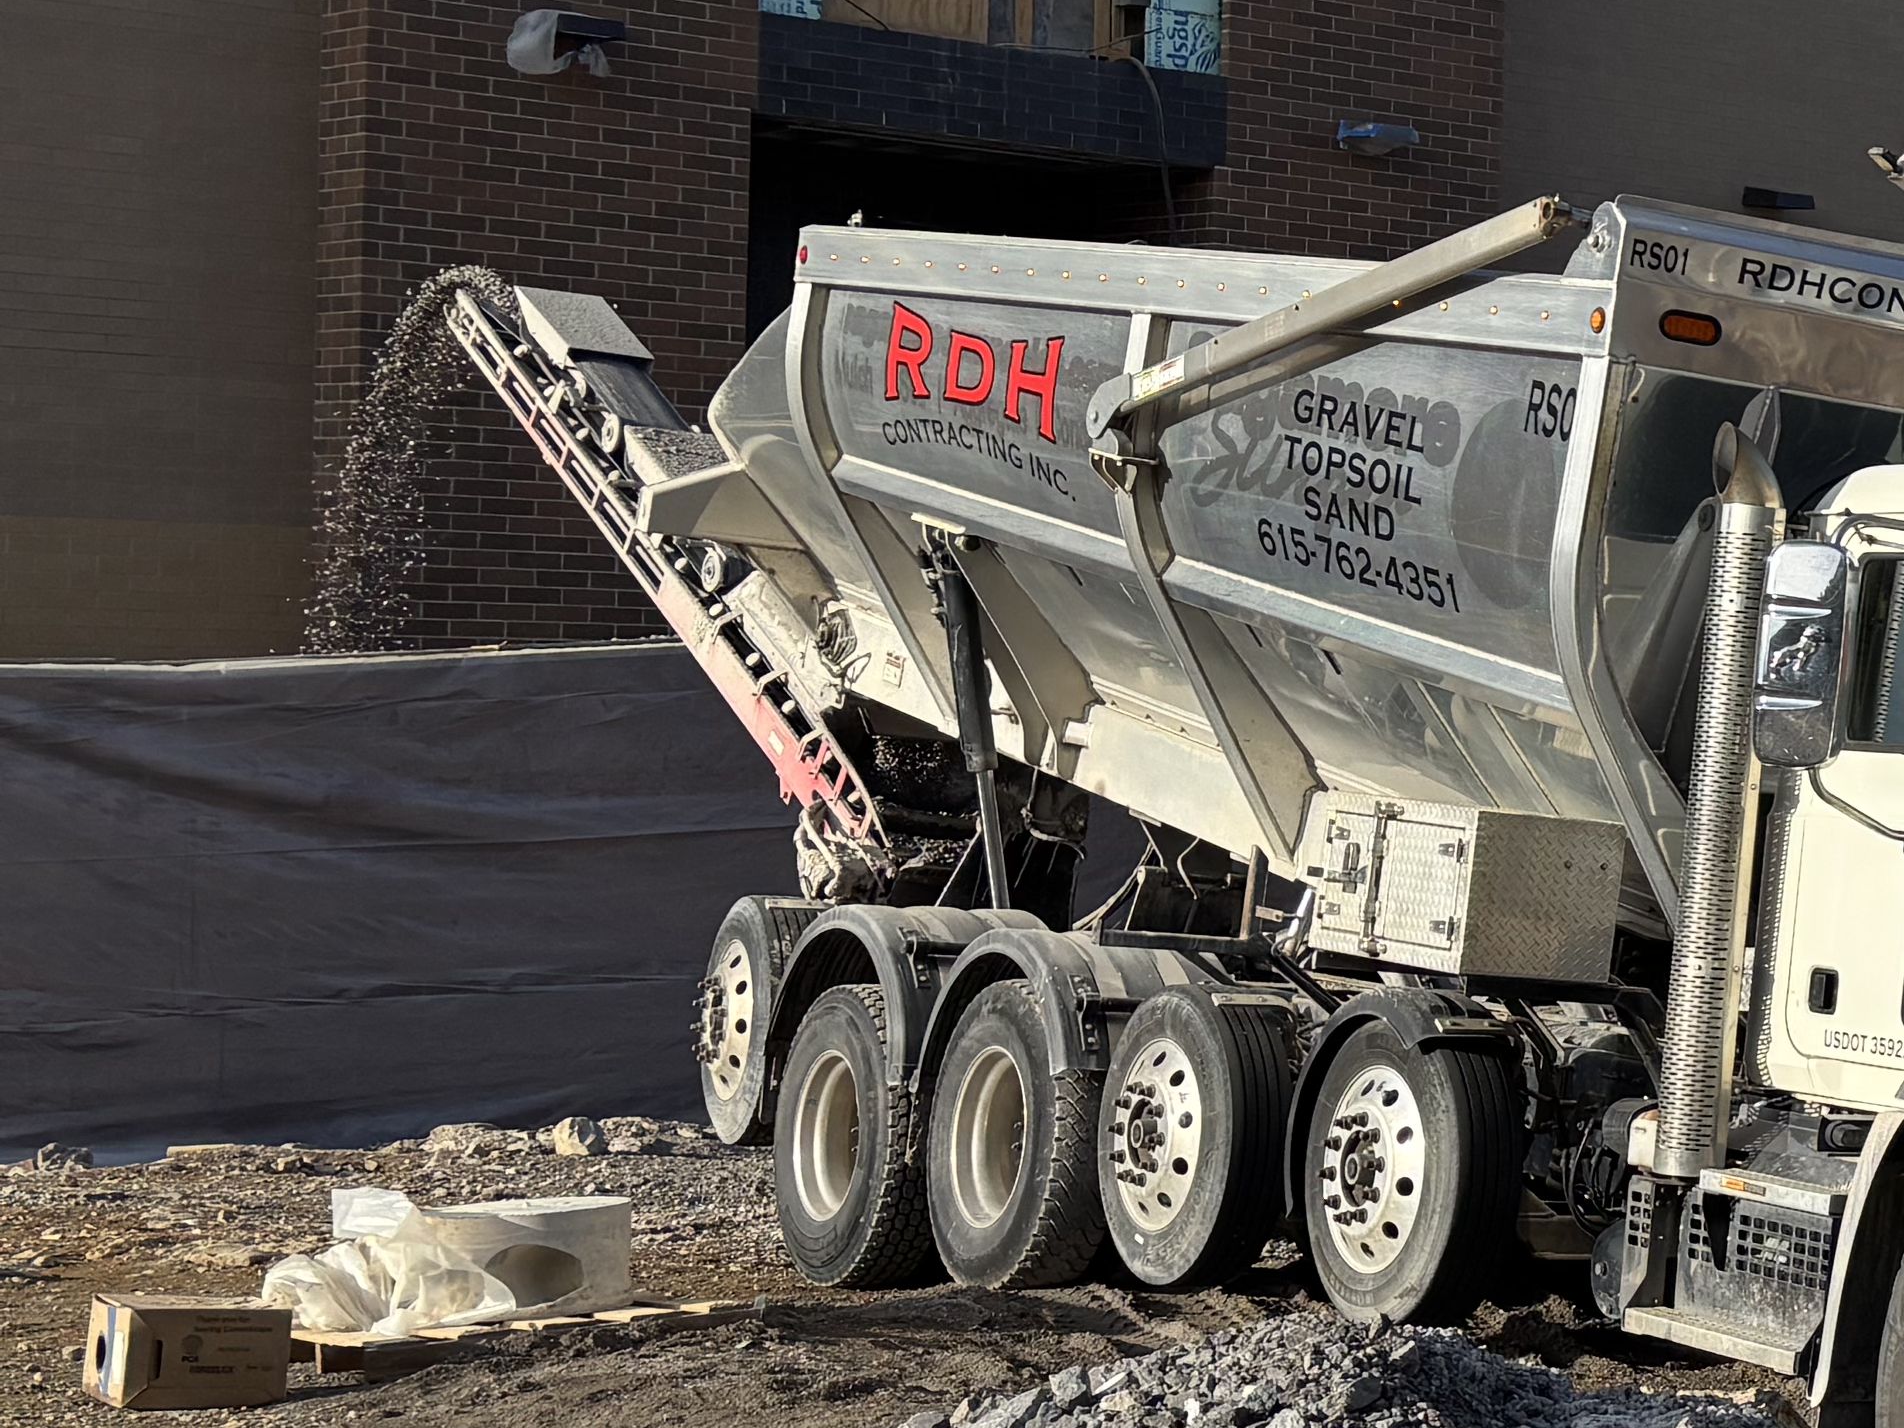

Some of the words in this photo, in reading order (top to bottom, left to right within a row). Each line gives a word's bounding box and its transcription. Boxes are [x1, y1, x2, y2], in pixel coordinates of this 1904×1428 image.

[1630, 238, 1690, 276] RS01
[884, 300, 1065, 444] RDH
[1293, 388, 1425, 454] GRAVEL
[882, 418, 1023, 470] CONTRACTING
[1028, 452, 1077, 502] INC.
[1283, 434, 1423, 507] TOPSOIL
[1303, 485, 1396, 542] SAND
[1256, 517, 1462, 614] 615-762-4351
[1824, 1028, 1868, 1053] USDOT
